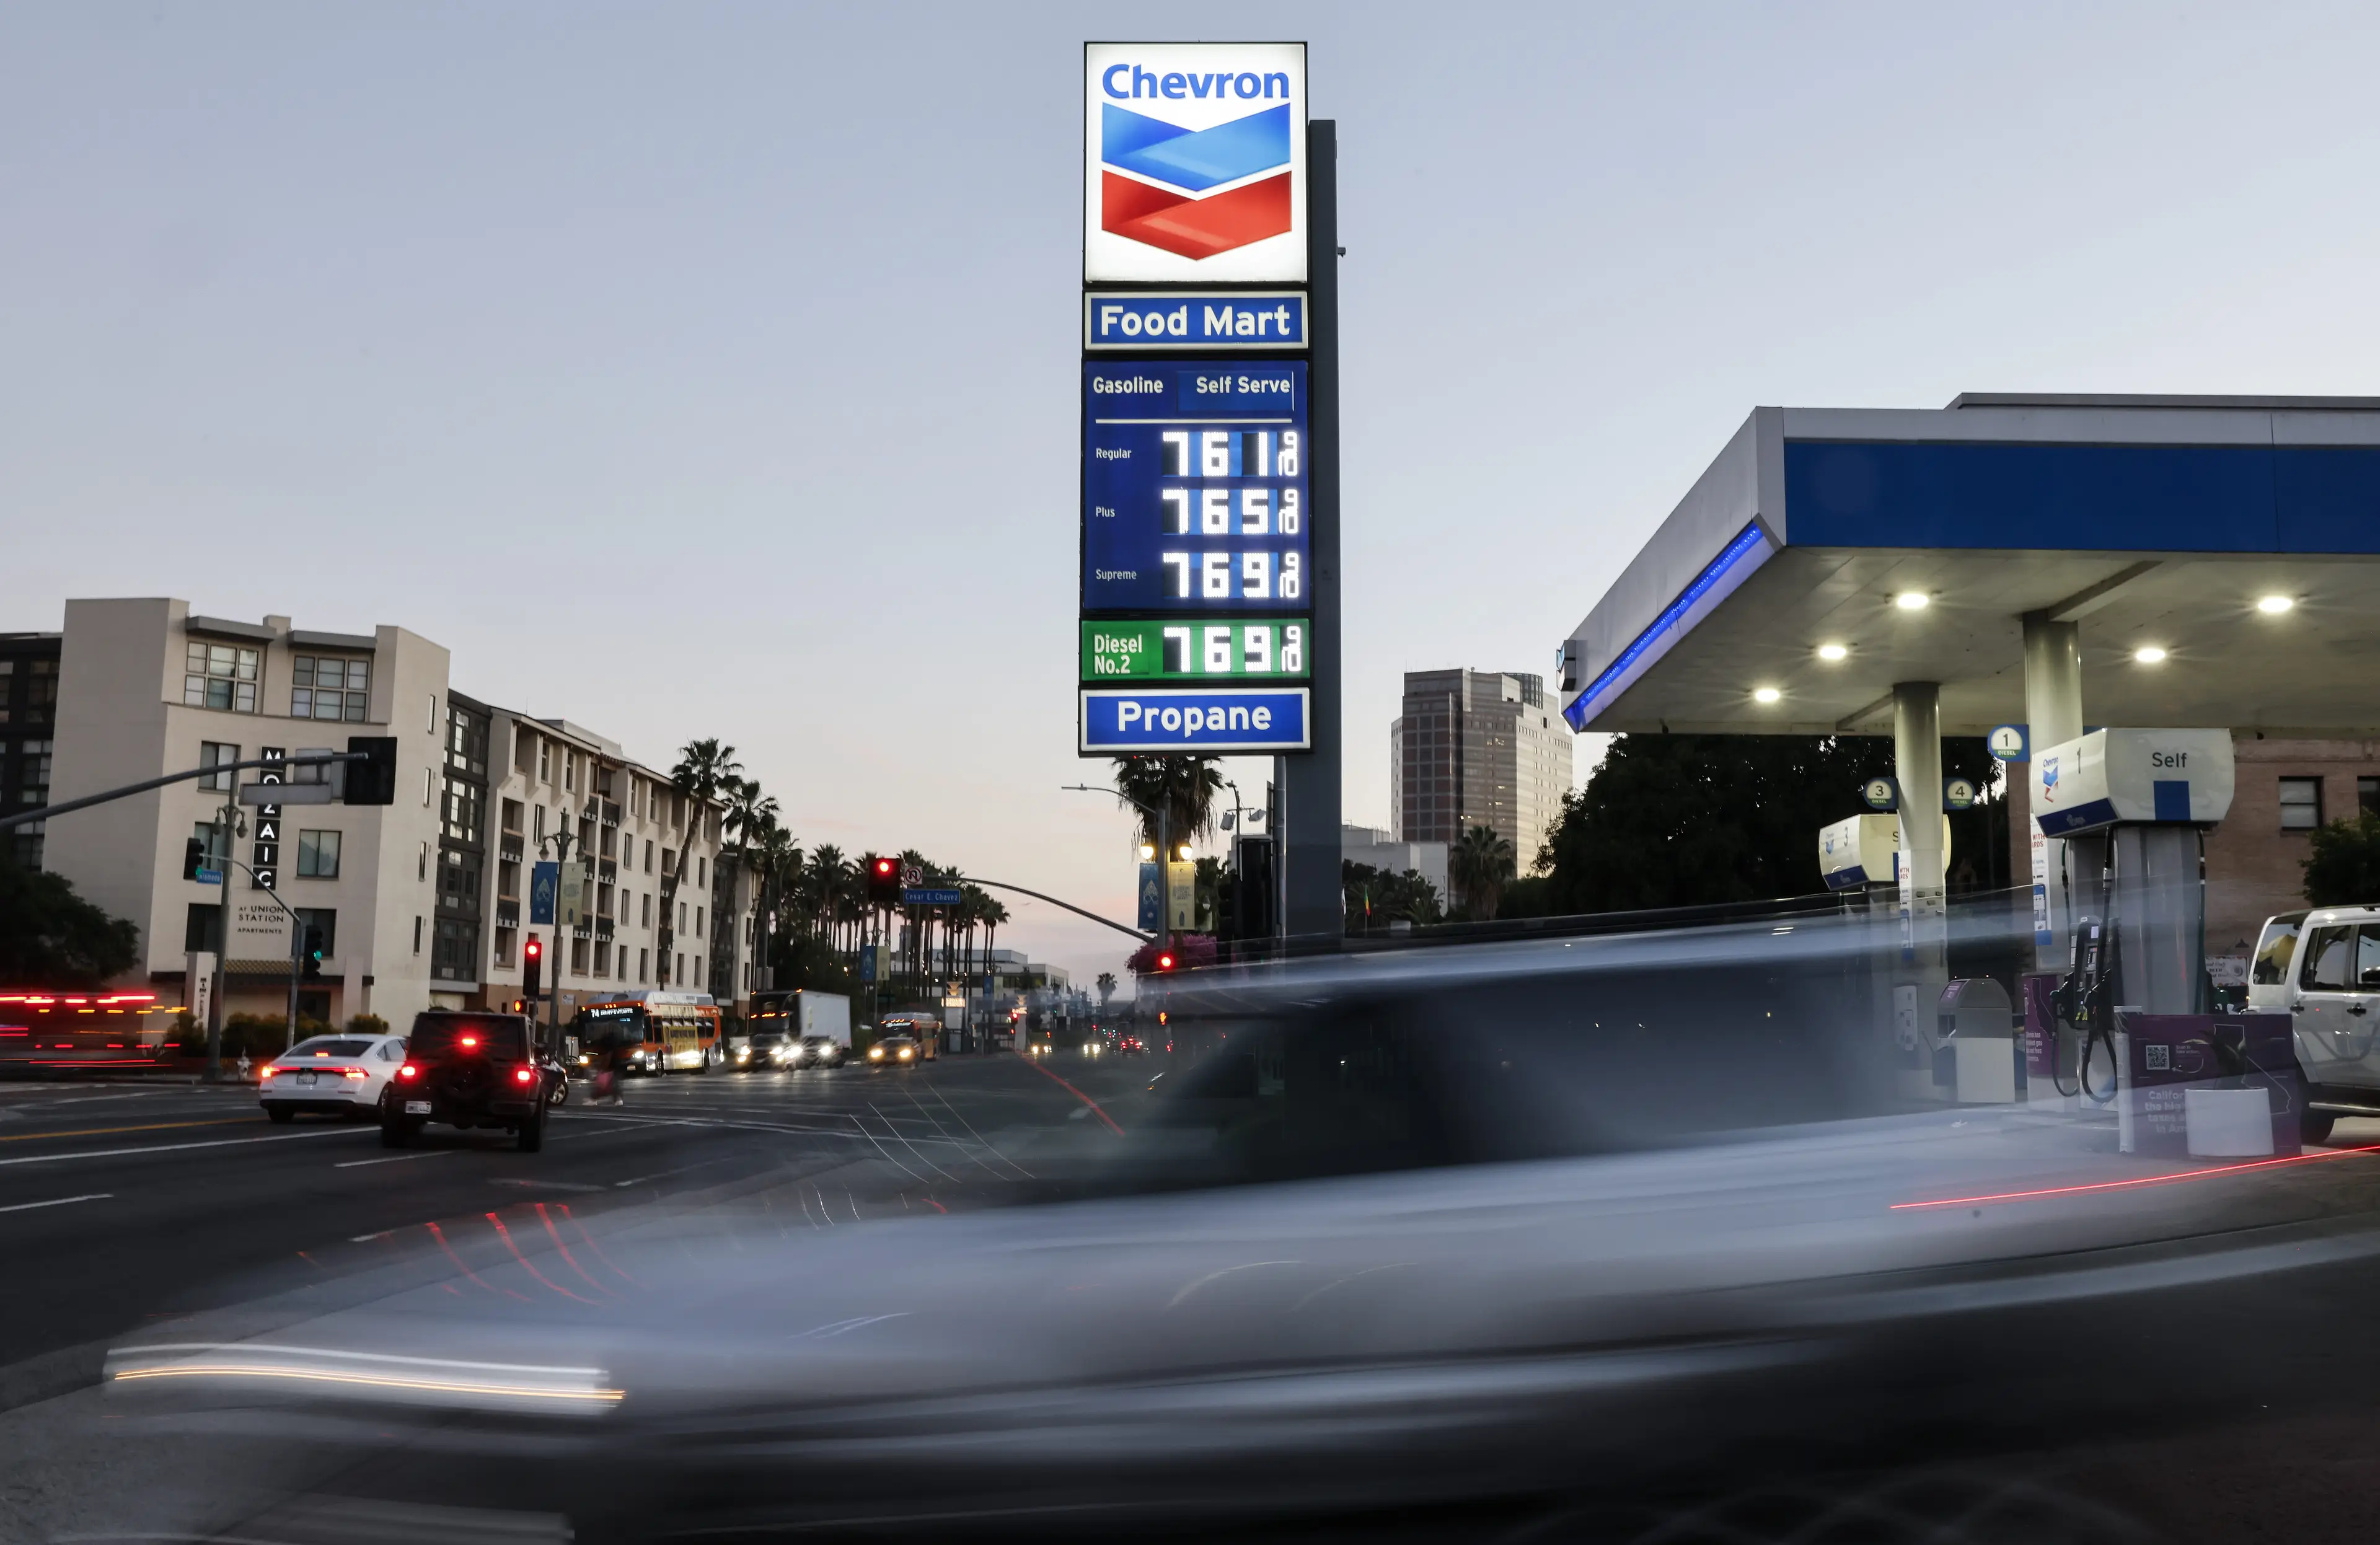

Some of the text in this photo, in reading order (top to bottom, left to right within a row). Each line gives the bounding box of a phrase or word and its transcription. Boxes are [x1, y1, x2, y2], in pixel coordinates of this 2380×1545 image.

[1102, 63, 1289, 99] Chevron
[1101, 304, 1290, 336] Food Mart
[1093, 376, 1290, 394] Gasoline Self Serve
[1096, 448, 1132, 460] Regular
[1162, 431, 1268, 477] 761
[1095, 507, 1116, 517] Plus
[1162, 489, 1269, 534] 765
[1096, 569, 1137, 581] Supreme
[1163, 552, 1269, 598] 769
[1094, 634, 1142, 654] Diesel
[1163, 625, 1272, 673] 769
[1094, 654, 1130, 674] No.2
[1117, 701, 1272, 738] Propane
[2002, 733, 2009, 747] 1
[2043, 747, 2081, 774] Chevron 1
[2152, 752, 2187, 768] Self
[1875, 785, 1884, 796] 3
[1955, 786, 1965, 797] 4
[935, 893, 958, 901] Chavez
[251, 905, 284, 913] UNION
[239, 914, 284, 923] STATION
[590, 1008, 600, 1018] 74
[2148, 1089, 2185, 1099] Califor
[2144, 1101, 2185, 1112] the hig
[2148, 1114, 2176, 1122] taxes
